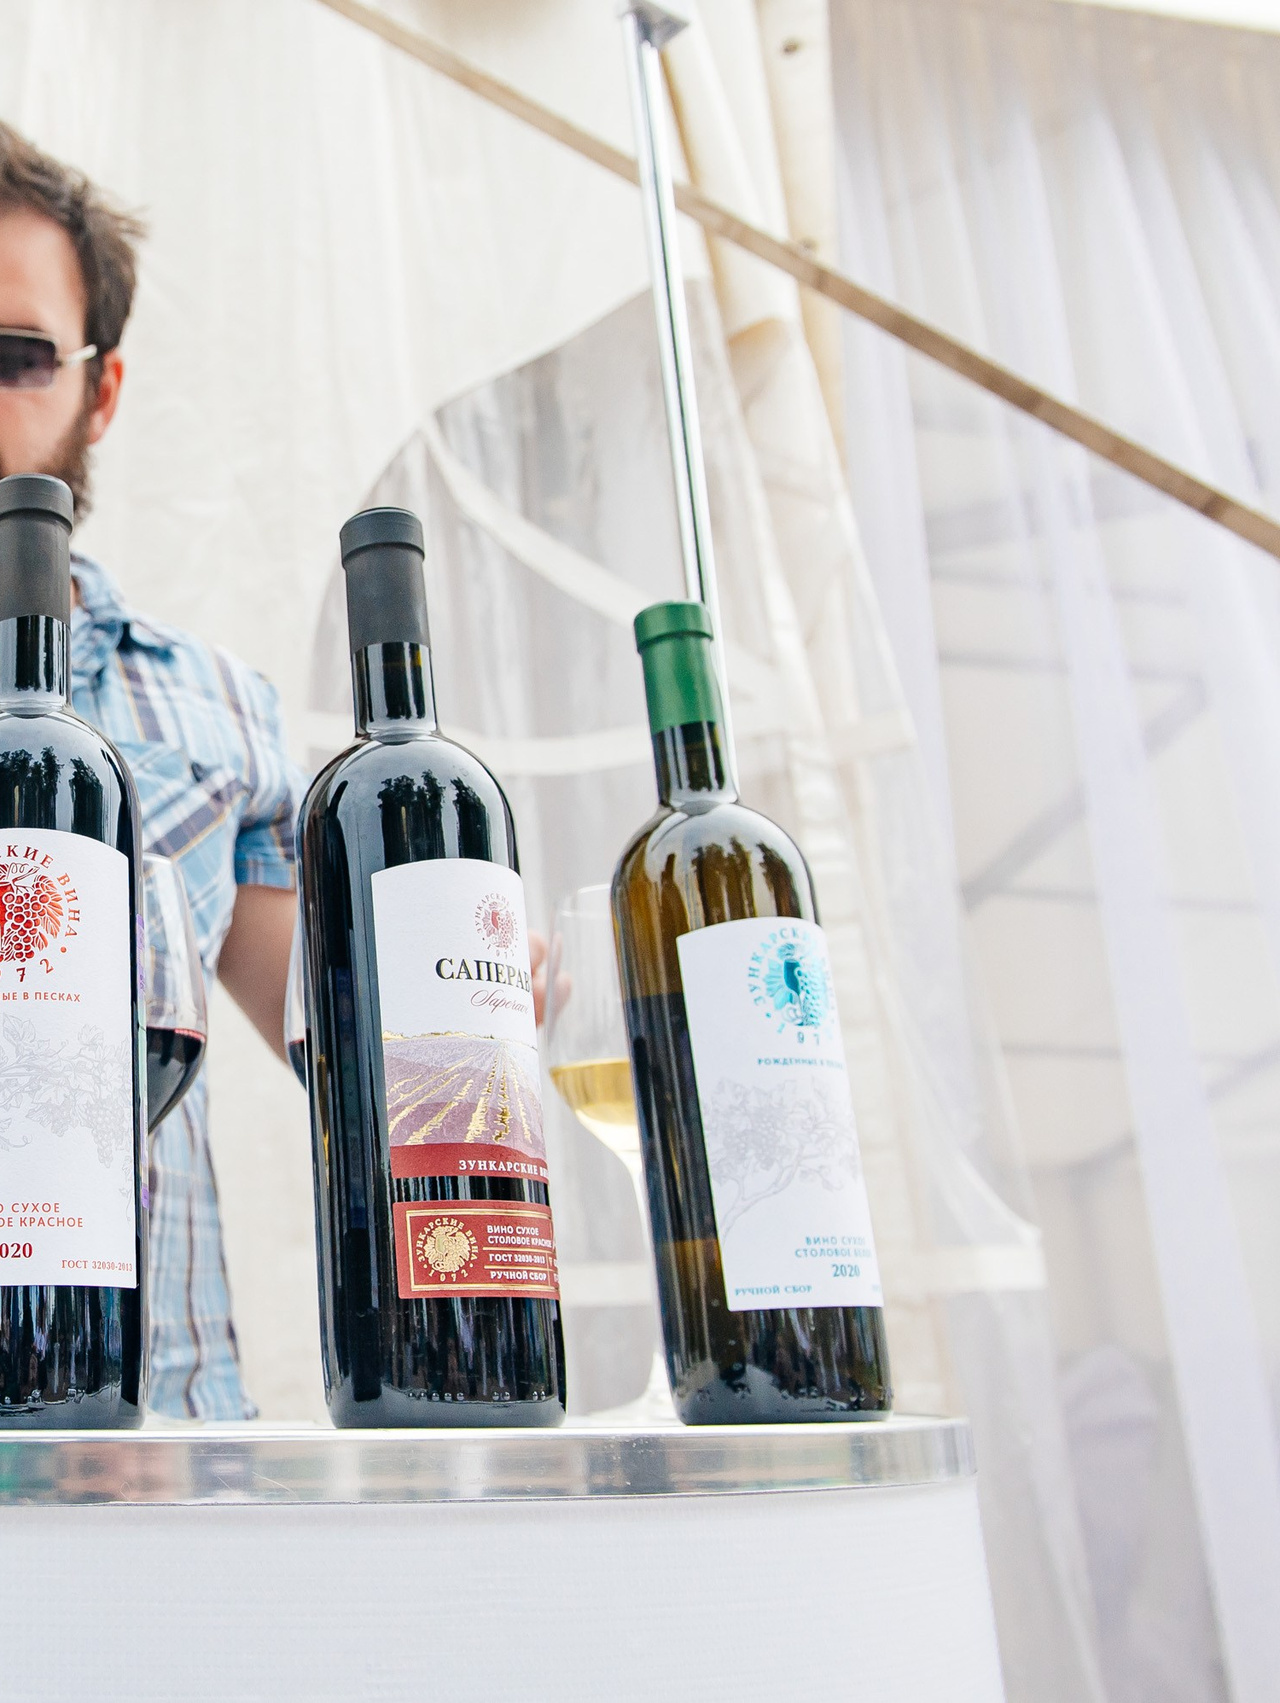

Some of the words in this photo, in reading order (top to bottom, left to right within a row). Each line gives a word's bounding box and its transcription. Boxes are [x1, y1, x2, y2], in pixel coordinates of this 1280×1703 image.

[57, 872, 81, 938] ВИНА
[434, 956, 531, 993] САПЕРАВ
[22, 991, 30, 1001] В
[34, 991, 81, 1004] ПЕСКАХ
[459, 1159, 539, 1175] ЗУНКАРСКИЕ
[11, 1201, 61, 1214] СУХОЕ
[19, 1216, 84, 1229] КРАСНОЕ
[486, 1224, 514, 1235] ВИНО
[515, 1226, 540, 1236] СУХОЕ
[415, 1217, 465, 1263] ЗУНКАРСКИЕ
[487, 1235, 531, 1246] СТОЛОВОЕ
[489, 1253, 513, 1262] ГОСТ
[61, 1259, 89, 1269] ГОСТ
[91, 1260, 133, 1272] 32030-2013
[831, 1263, 861, 1278] 2020
[490, 1270, 529, 1281] РУЧНОЙ
[528, 1271, 548, 1282] СБОР
